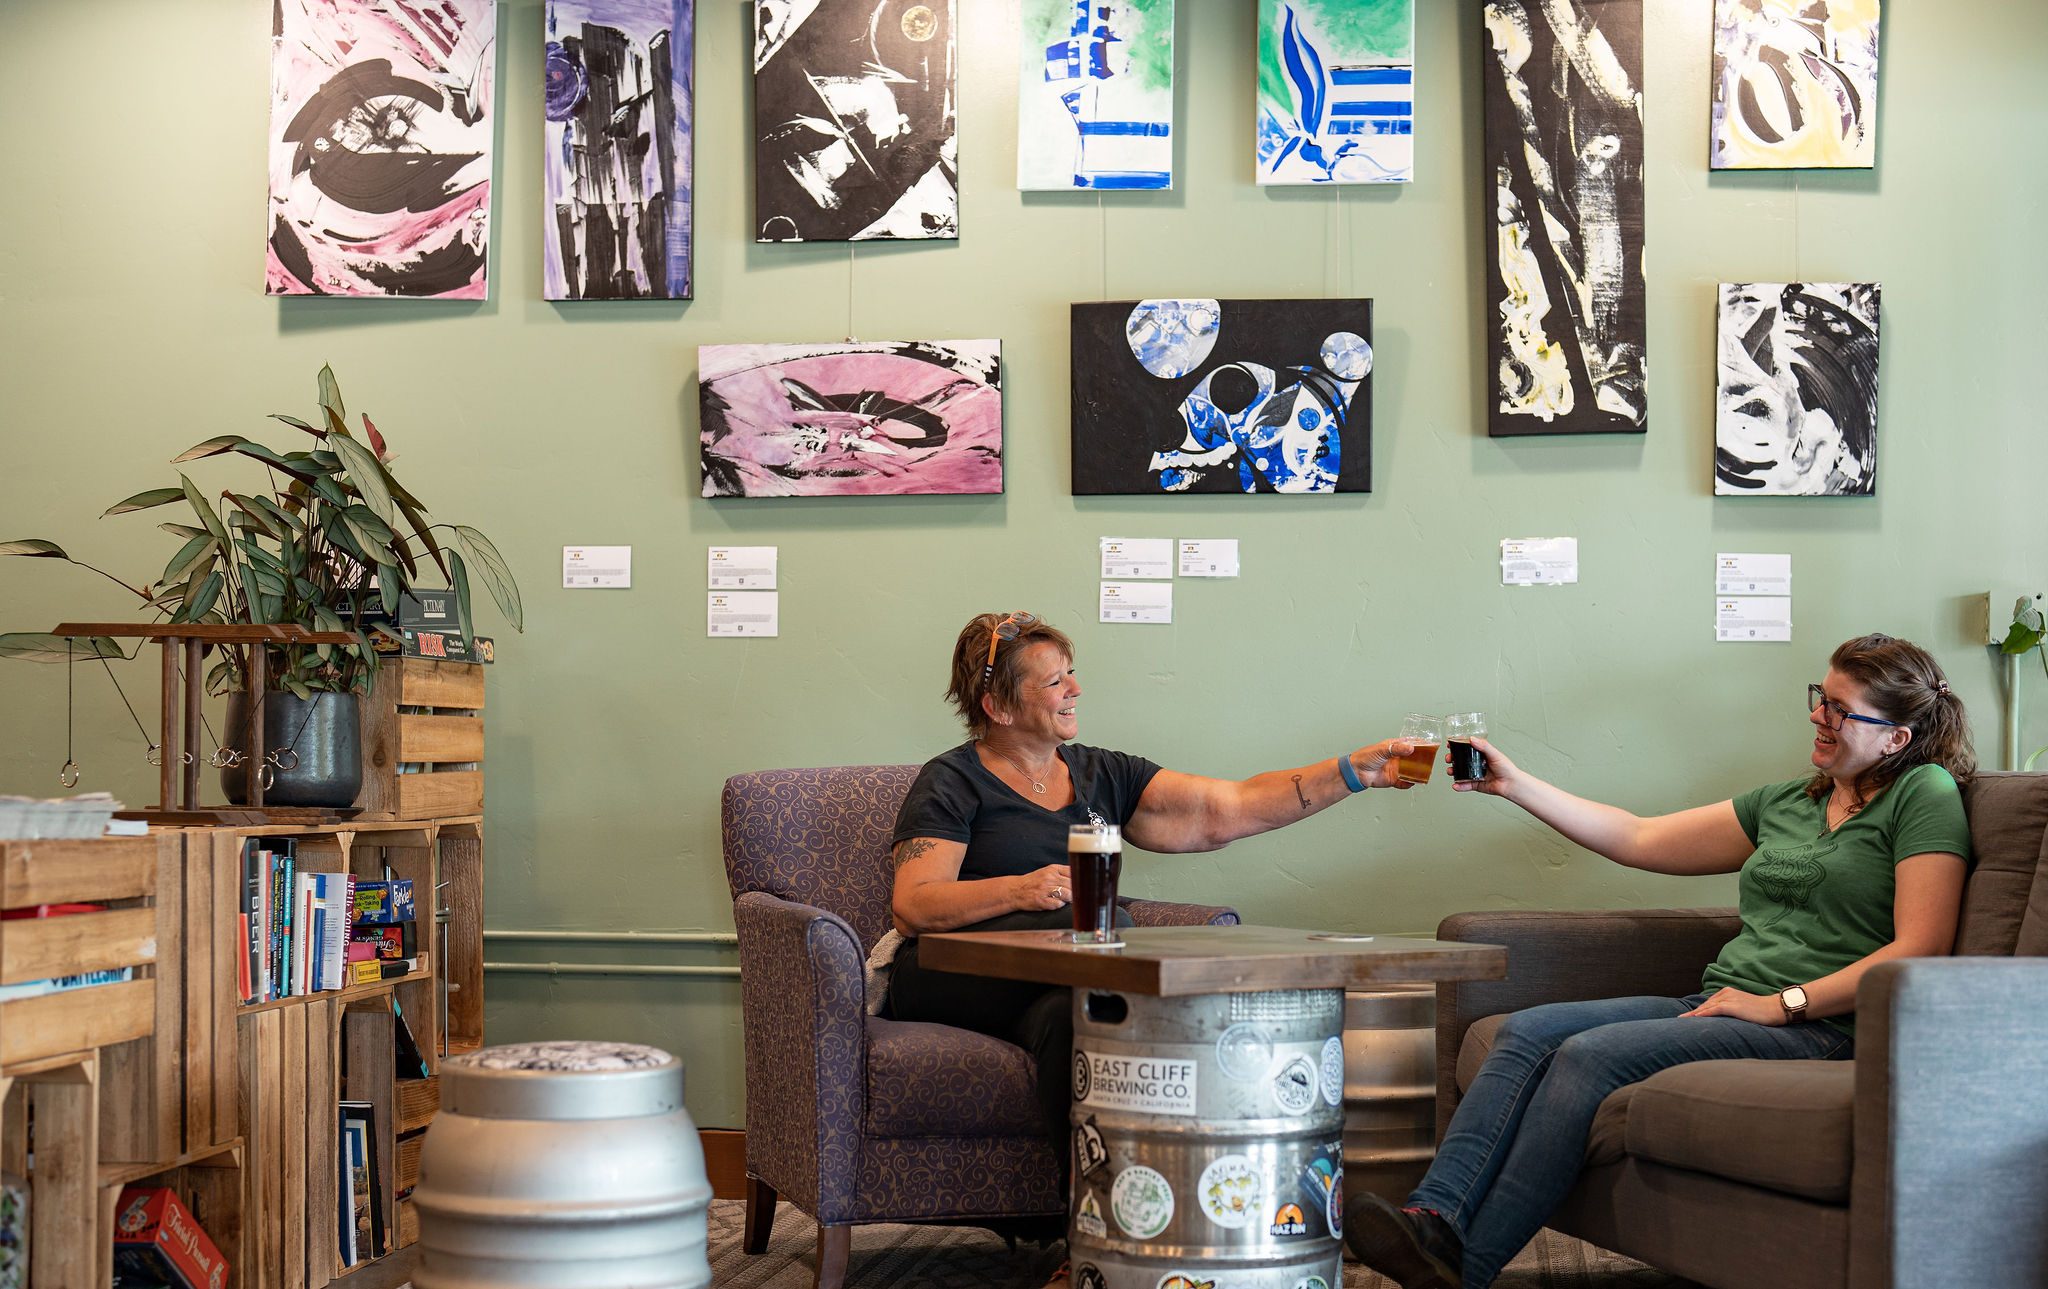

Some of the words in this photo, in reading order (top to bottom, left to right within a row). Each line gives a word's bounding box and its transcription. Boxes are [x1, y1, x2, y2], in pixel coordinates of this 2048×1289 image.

[417, 633, 447, 657] RISK
[393, 884, 409, 907] Farkle
[252, 896, 260, 953] BEER
[1093, 1059, 1131, 1077] EAST
[1138, 1063, 1191, 1081] CLIFF
[1093, 1076, 1157, 1097] BREWING
[1162, 1083, 1191, 1099] CO.
[166, 1203, 192, 1248] Trivial
